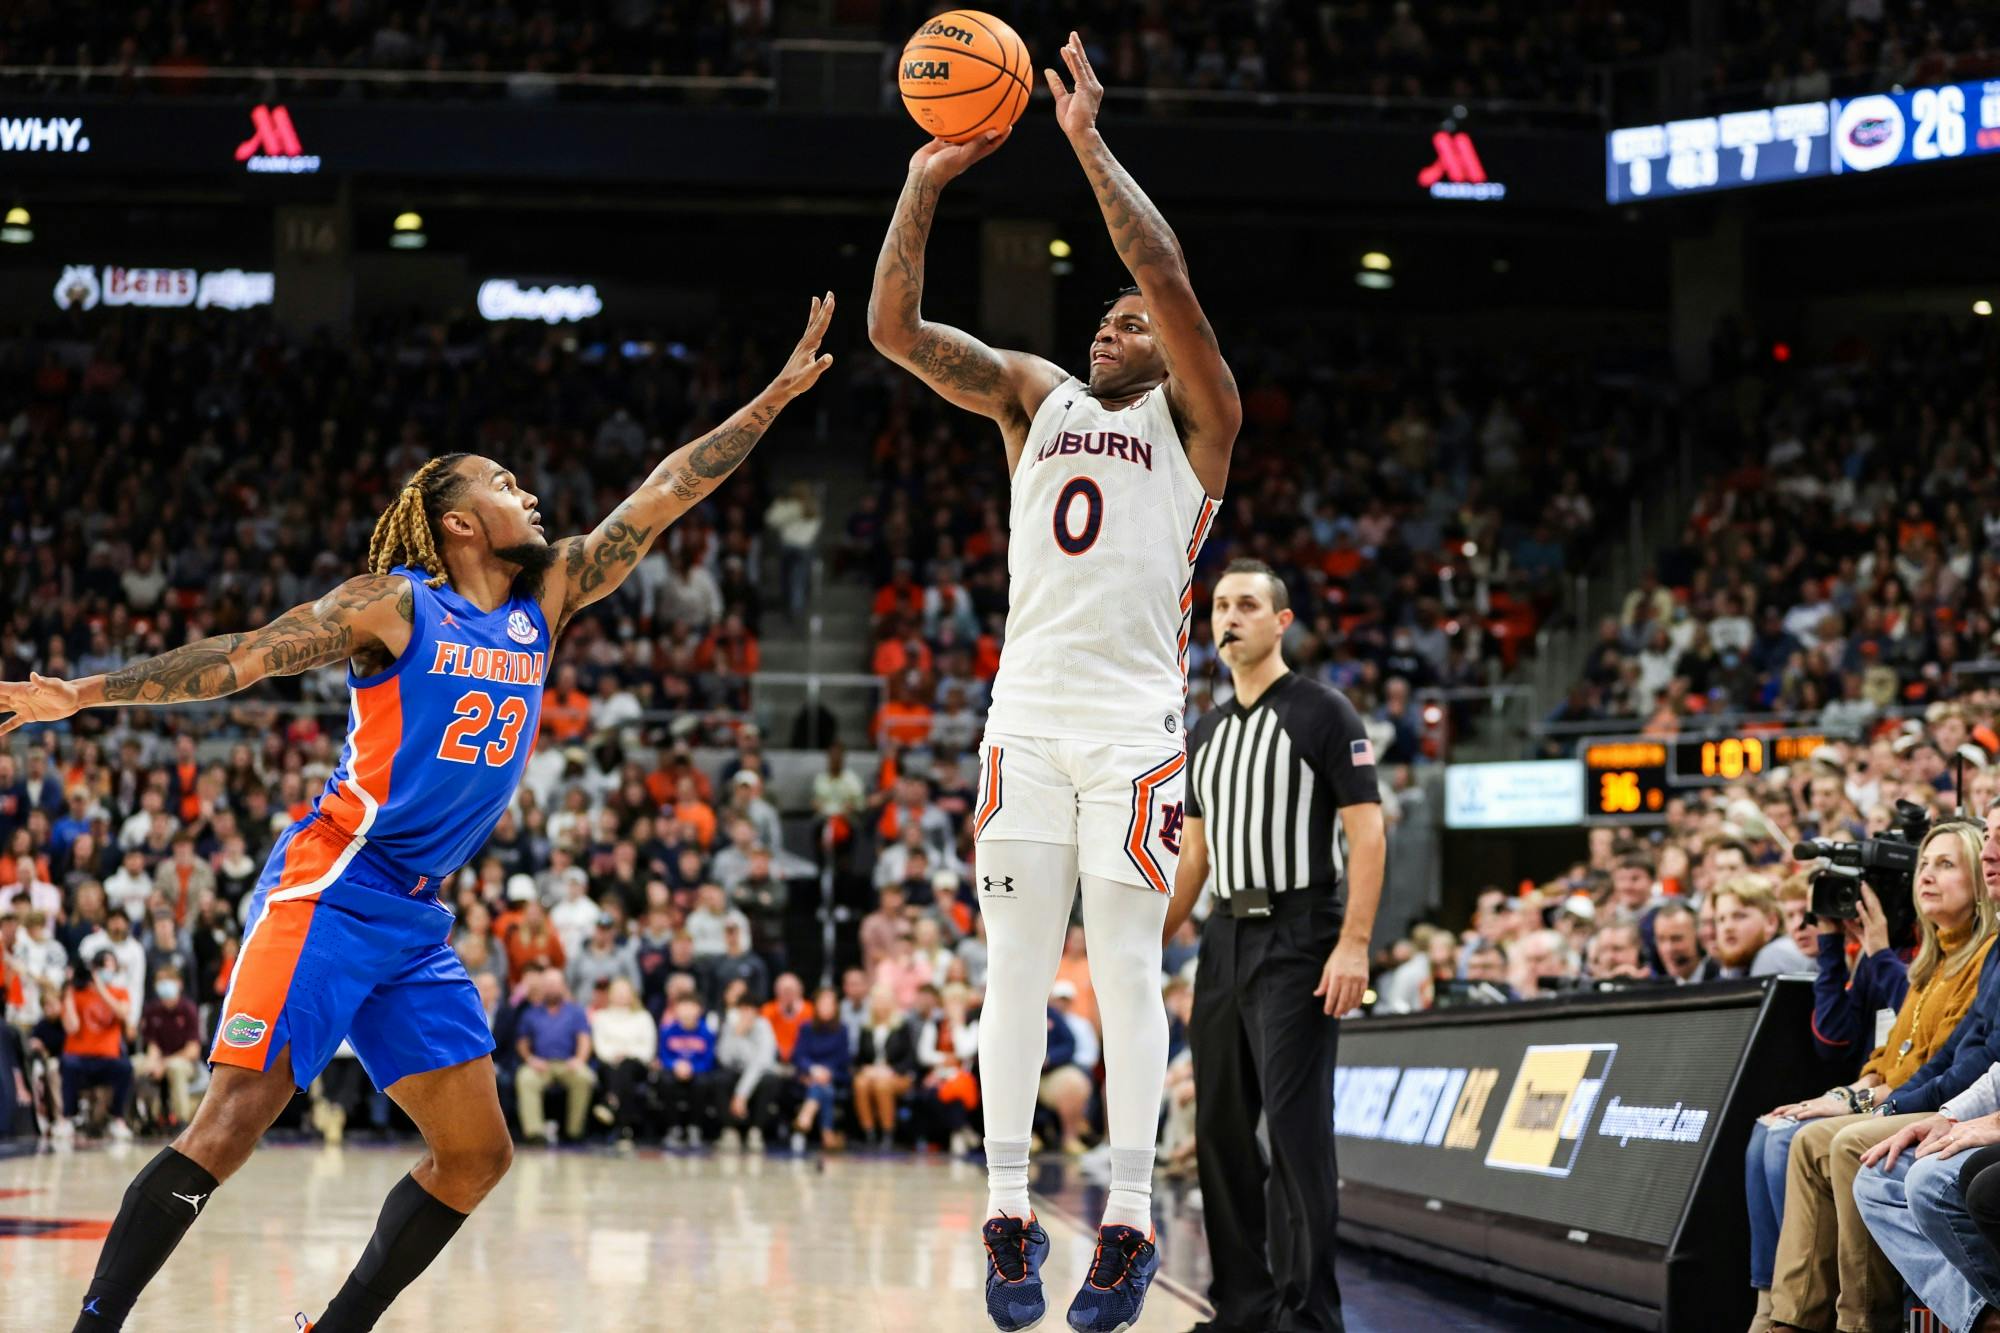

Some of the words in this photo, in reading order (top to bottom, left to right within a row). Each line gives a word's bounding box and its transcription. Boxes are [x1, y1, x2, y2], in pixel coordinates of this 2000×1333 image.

[916, 19, 974, 46] ilson
[903, 61, 949, 80] NCAA
[0, 117, 90, 152] WHY.
[1912, 85, 1966, 160] 26
[1052, 475, 1104, 557] 0
[427, 640, 544, 687] FLORIDA
[437, 690, 528, 768] 23
